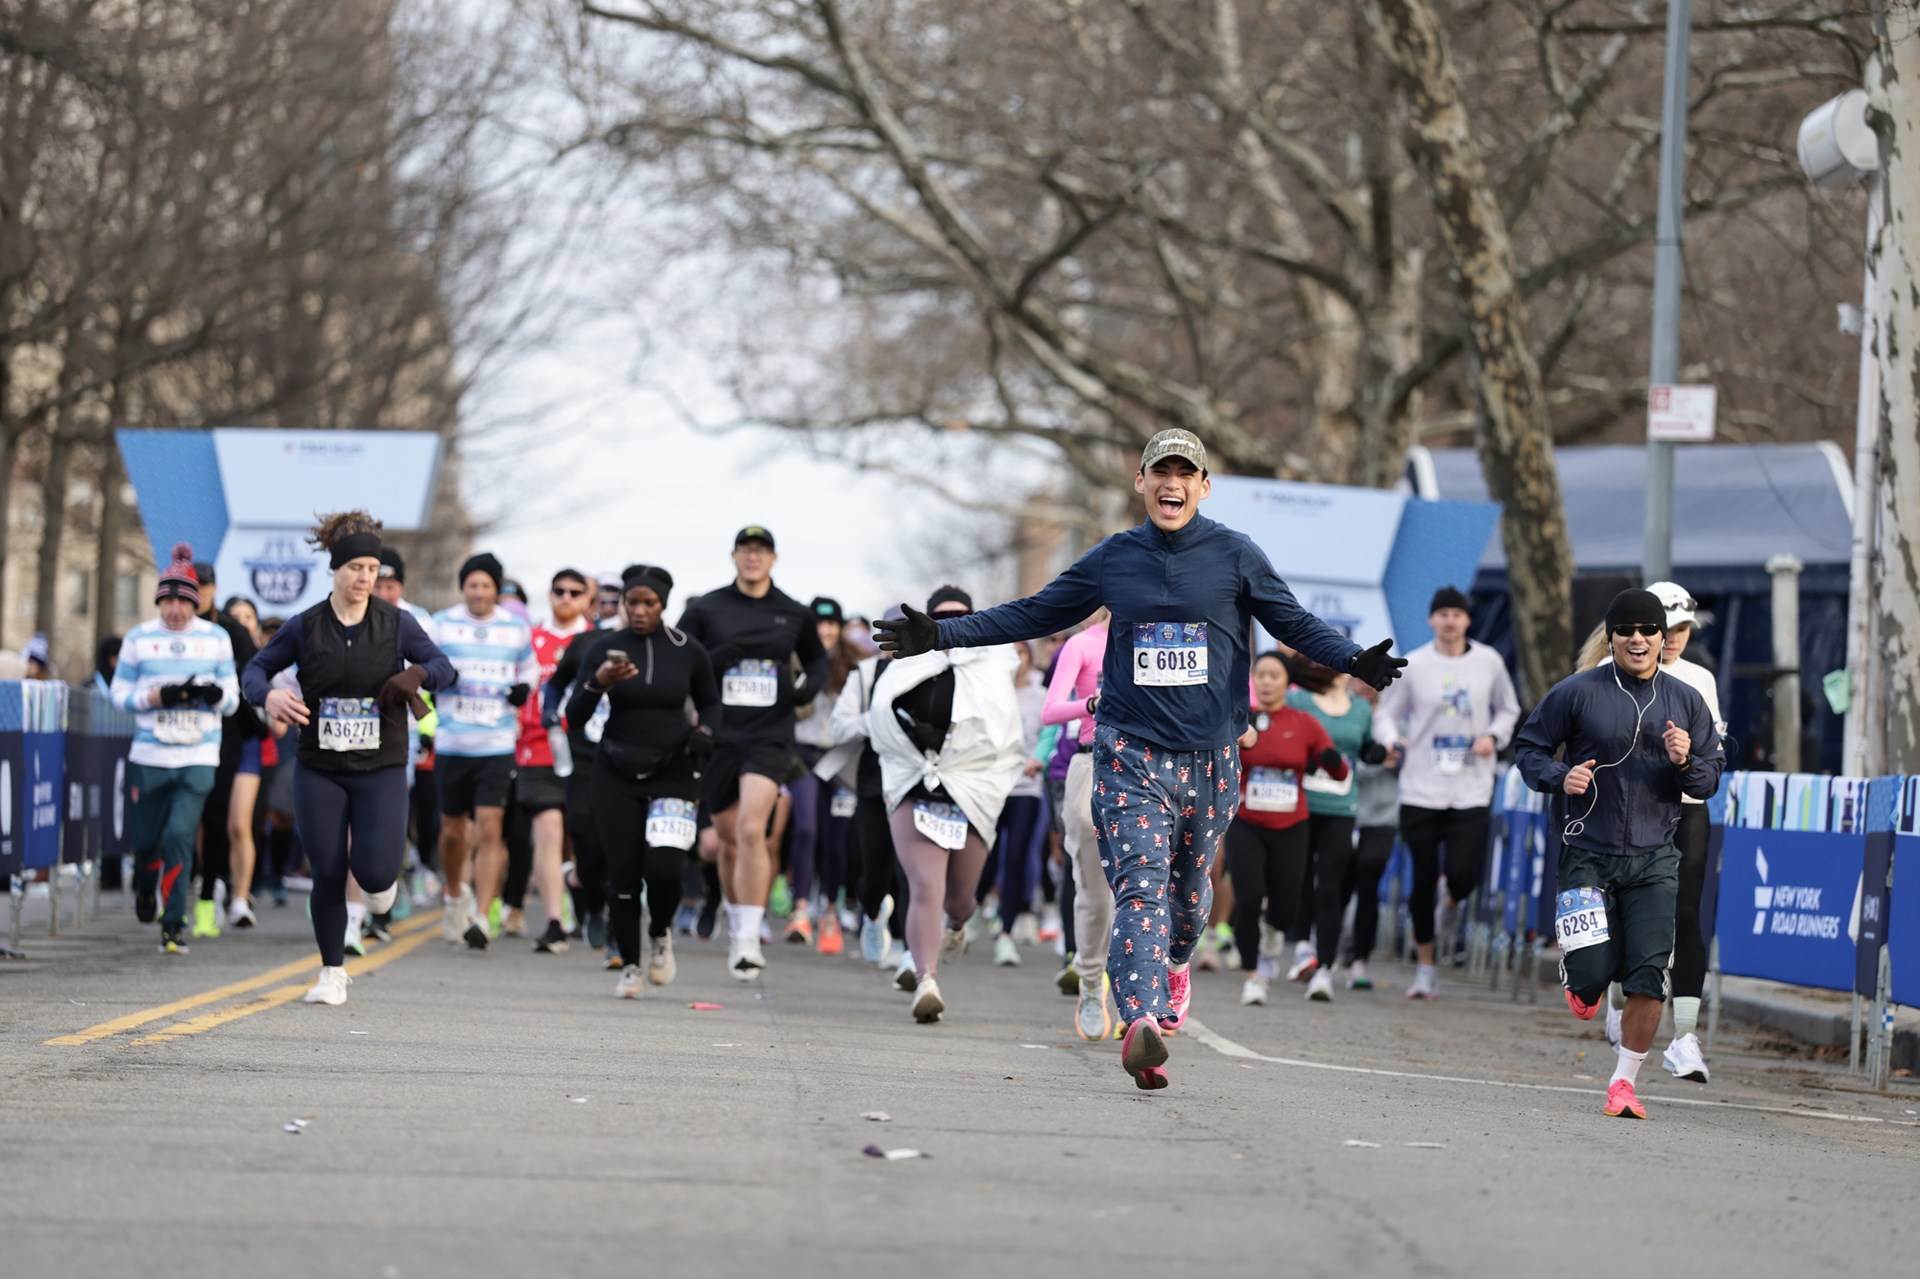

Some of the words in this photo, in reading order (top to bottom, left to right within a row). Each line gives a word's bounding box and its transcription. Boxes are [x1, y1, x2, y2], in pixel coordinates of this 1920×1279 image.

[1138, 652, 1149, 669] C
[1157, 651, 1198, 671] 6018
[323, 721, 374, 738] A36271
[1773, 885, 1797, 909] NEW
[1795, 886, 1822, 911] YORK
[1563, 911, 1599, 937] 6284
[1770, 911, 1797, 935] ROAD
[1796, 913, 1840, 939] RUNNERS
